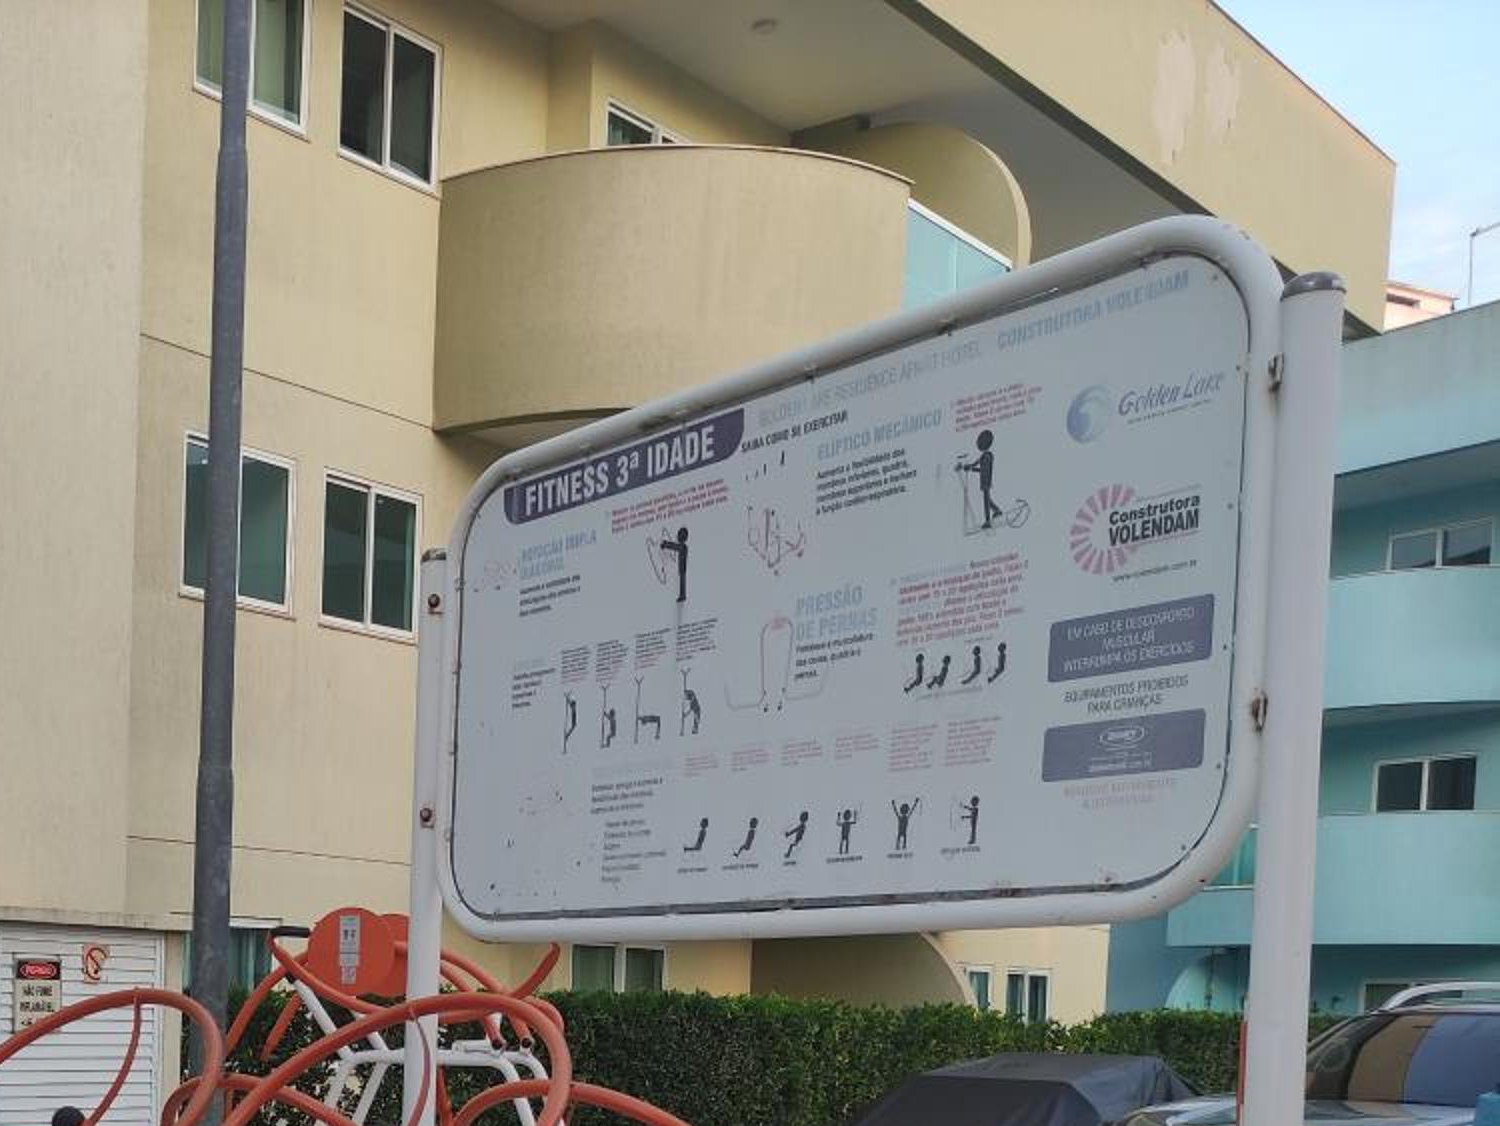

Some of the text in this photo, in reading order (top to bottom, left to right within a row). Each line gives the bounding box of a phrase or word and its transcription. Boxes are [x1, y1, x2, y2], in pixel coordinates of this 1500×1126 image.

[997, 269, 1189, 350] CONSTRUTORA VOLENDAM
[1117, 381, 1181, 417] Golden
[1183, 370, 1225, 399] Lake
[803, 409, 848, 436] EXERCITAR
[873, 405, 942, 445] MECÂNICO
[525, 461, 609, 516] FITNESS
[647, 425, 715, 478] IDADE
[1109, 495, 1200, 525] Construtora
[1108, 507, 1199, 547] VOLENDAM
[796, 583, 863, 616] PRESSÃO
[796, 608, 878, 641] DE PERNAS
[1067, 624, 1083, 641] EM
[1084, 621, 1109, 639] CASO
[1110, 618, 1124, 634] DE
[1102, 630, 1155, 650] MUSCULAR
[1123, 649, 1138, 664] OS
[1064, 681, 1135, 704] EQUIPAMENTOS
[1087, 699, 1112, 715] PARA
